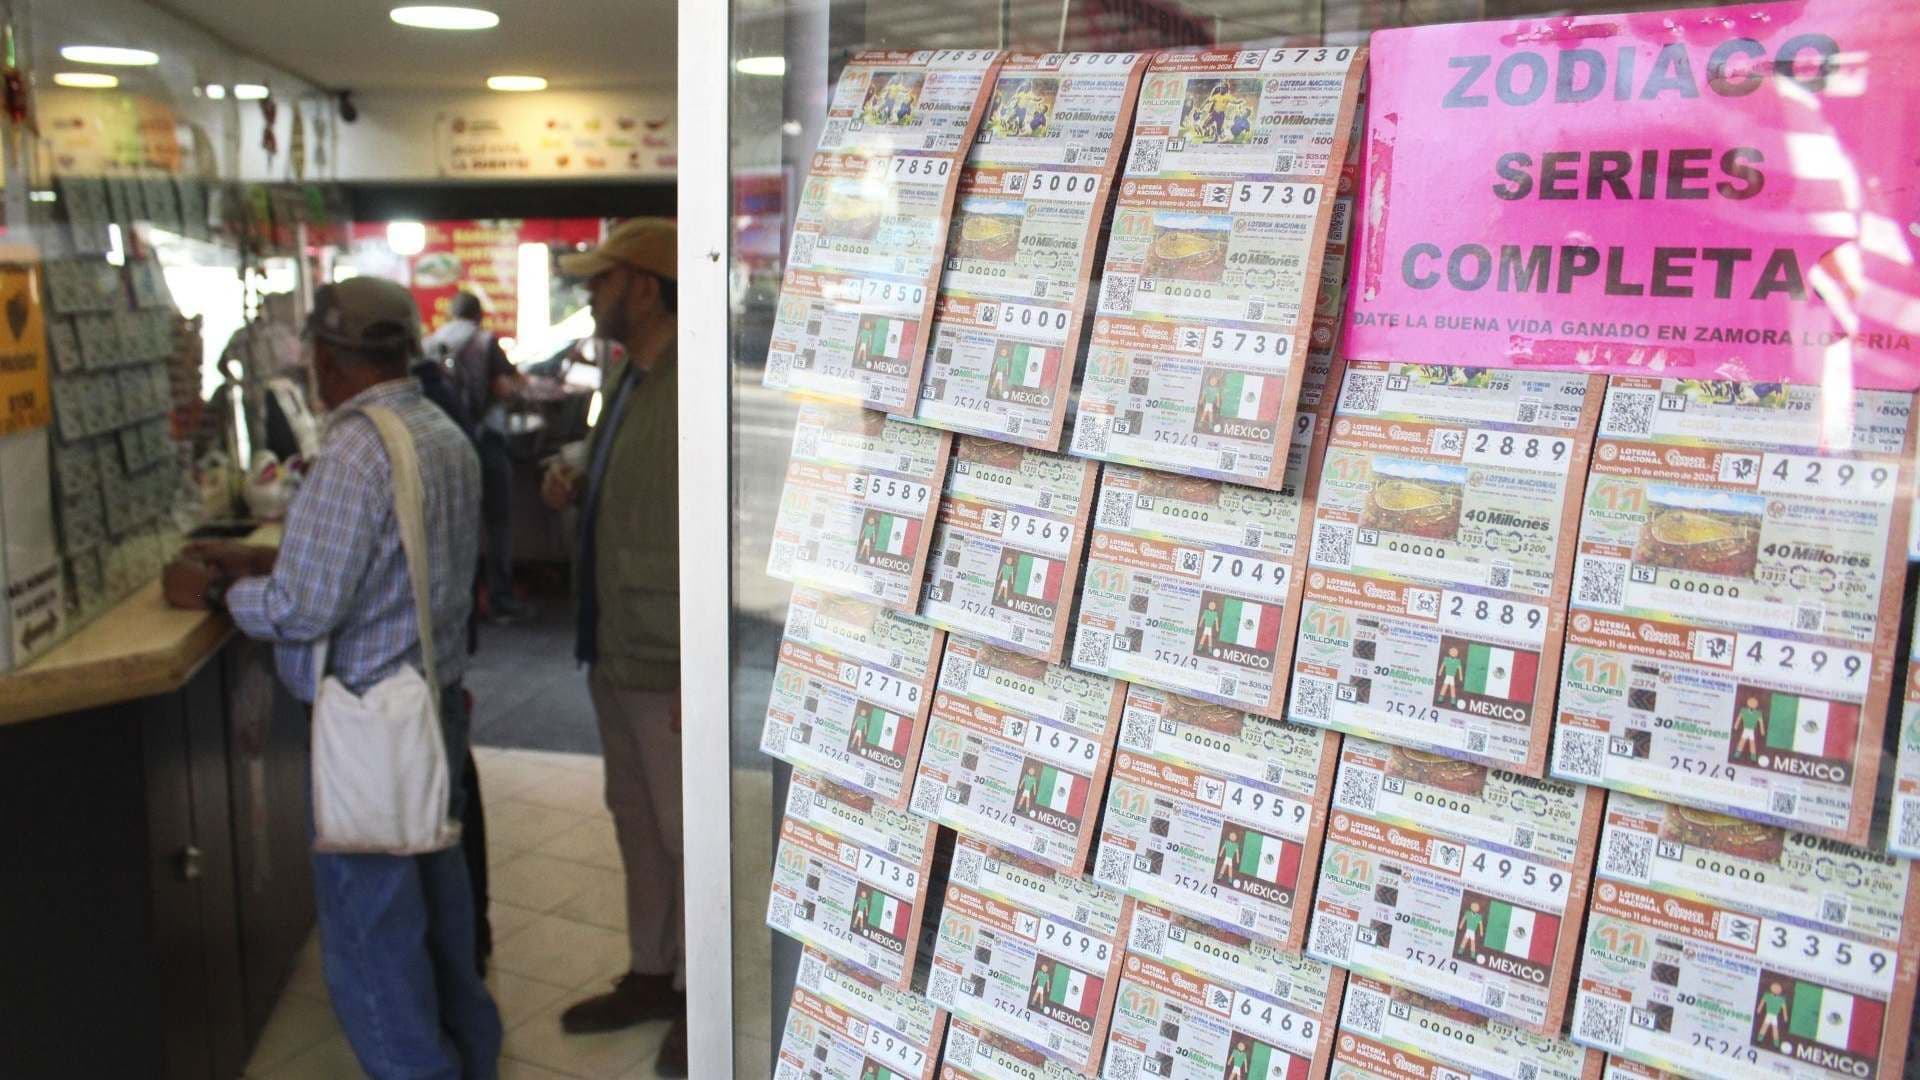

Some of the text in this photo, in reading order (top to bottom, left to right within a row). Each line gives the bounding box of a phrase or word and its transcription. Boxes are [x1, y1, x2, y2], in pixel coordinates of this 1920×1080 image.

[937, 51, 991, 61] 7850
[1069, 55, 1134, 65] 5000
[1272, 49, 1350, 62] 5730
[1442, 34, 1840, 109] ZODIACO
[895, 159, 948, 176] 7850
[1493, 148, 1765, 200] SERIES
[1032, 175, 1095, 193] 5000
[1241, 185, 1316, 205] 5730
[1403, 243, 1836, 300] COMPLETA
[870, 282, 921, 303] 7850
[1005, 308, 1065, 330] 5000
[1353, 312, 1399, 326] DATE
[1406, 315, 1428, 328] LA
[1434, 316, 1499, 332] BUENA
[1507, 319, 1552, 334] VIDA
[1560, 320, 1649, 339] GANADO
[1657, 326, 1687, 341] EN
[1694, 327, 1793, 345] ZAMORA
[1213, 332, 1288, 356] 5730
[1476, 433, 1566, 461] 2889
[1773, 459, 1888, 487] 4299
[872, 479, 926, 502] 5589
[1012, 516, 1069, 542] 9569
[1212, 555, 1285, 585] 7049
[1451, 597, 1540, 628] 2889
[1748, 641, 1861, 677] 4299
[865, 672, 917, 702] 2718
[1036, 726, 1094, 759] 1678
[1232, 788, 1305, 823] 4959
[863, 854, 915, 888] 7138
[1473, 853, 1563, 891] 4959
[1046, 925, 1107, 960] 9698
[1771, 928, 1886, 974] 3359
[1241, 998, 1312, 1038] 6468
[871, 1030, 922, 1065] 5947
